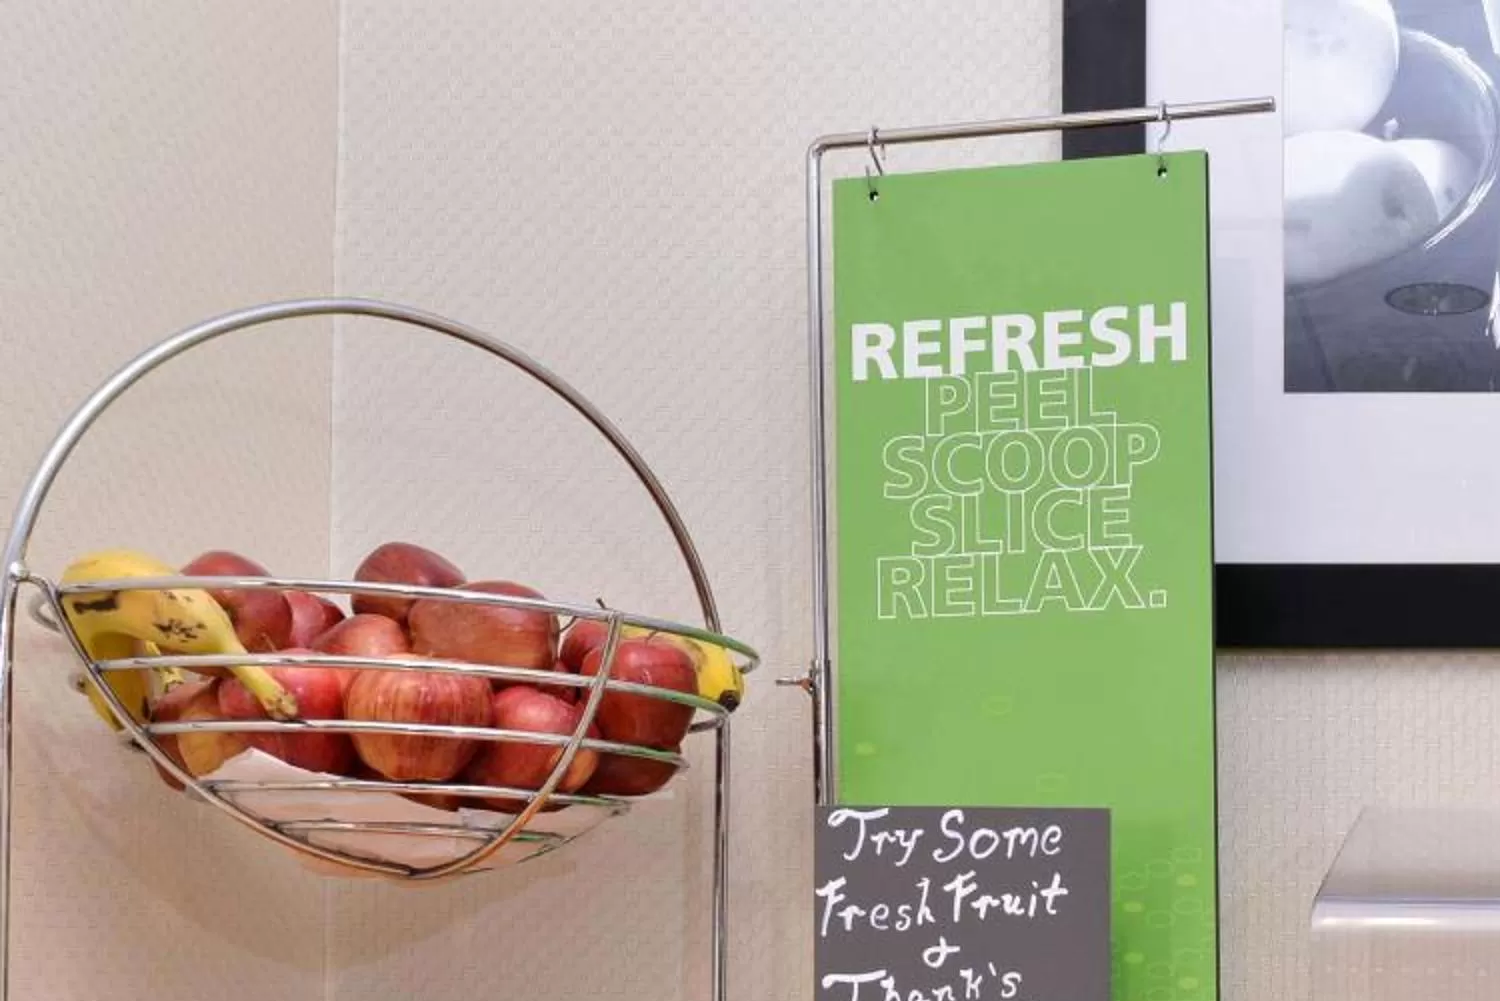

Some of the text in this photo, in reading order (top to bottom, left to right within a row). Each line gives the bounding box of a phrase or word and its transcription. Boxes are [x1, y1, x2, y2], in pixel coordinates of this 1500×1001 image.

[851, 302, 1188, 381] REFRESH
[926, 366, 1117, 437] PEEL
[882, 423, 1161, 499] SCOOP
[909, 484, 1133, 559] SLICE
[877, 545, 1168, 620] RELAX.
[827, 807, 1063, 867] Try Some
[815, 870, 1069, 937] Fresh Fruit
